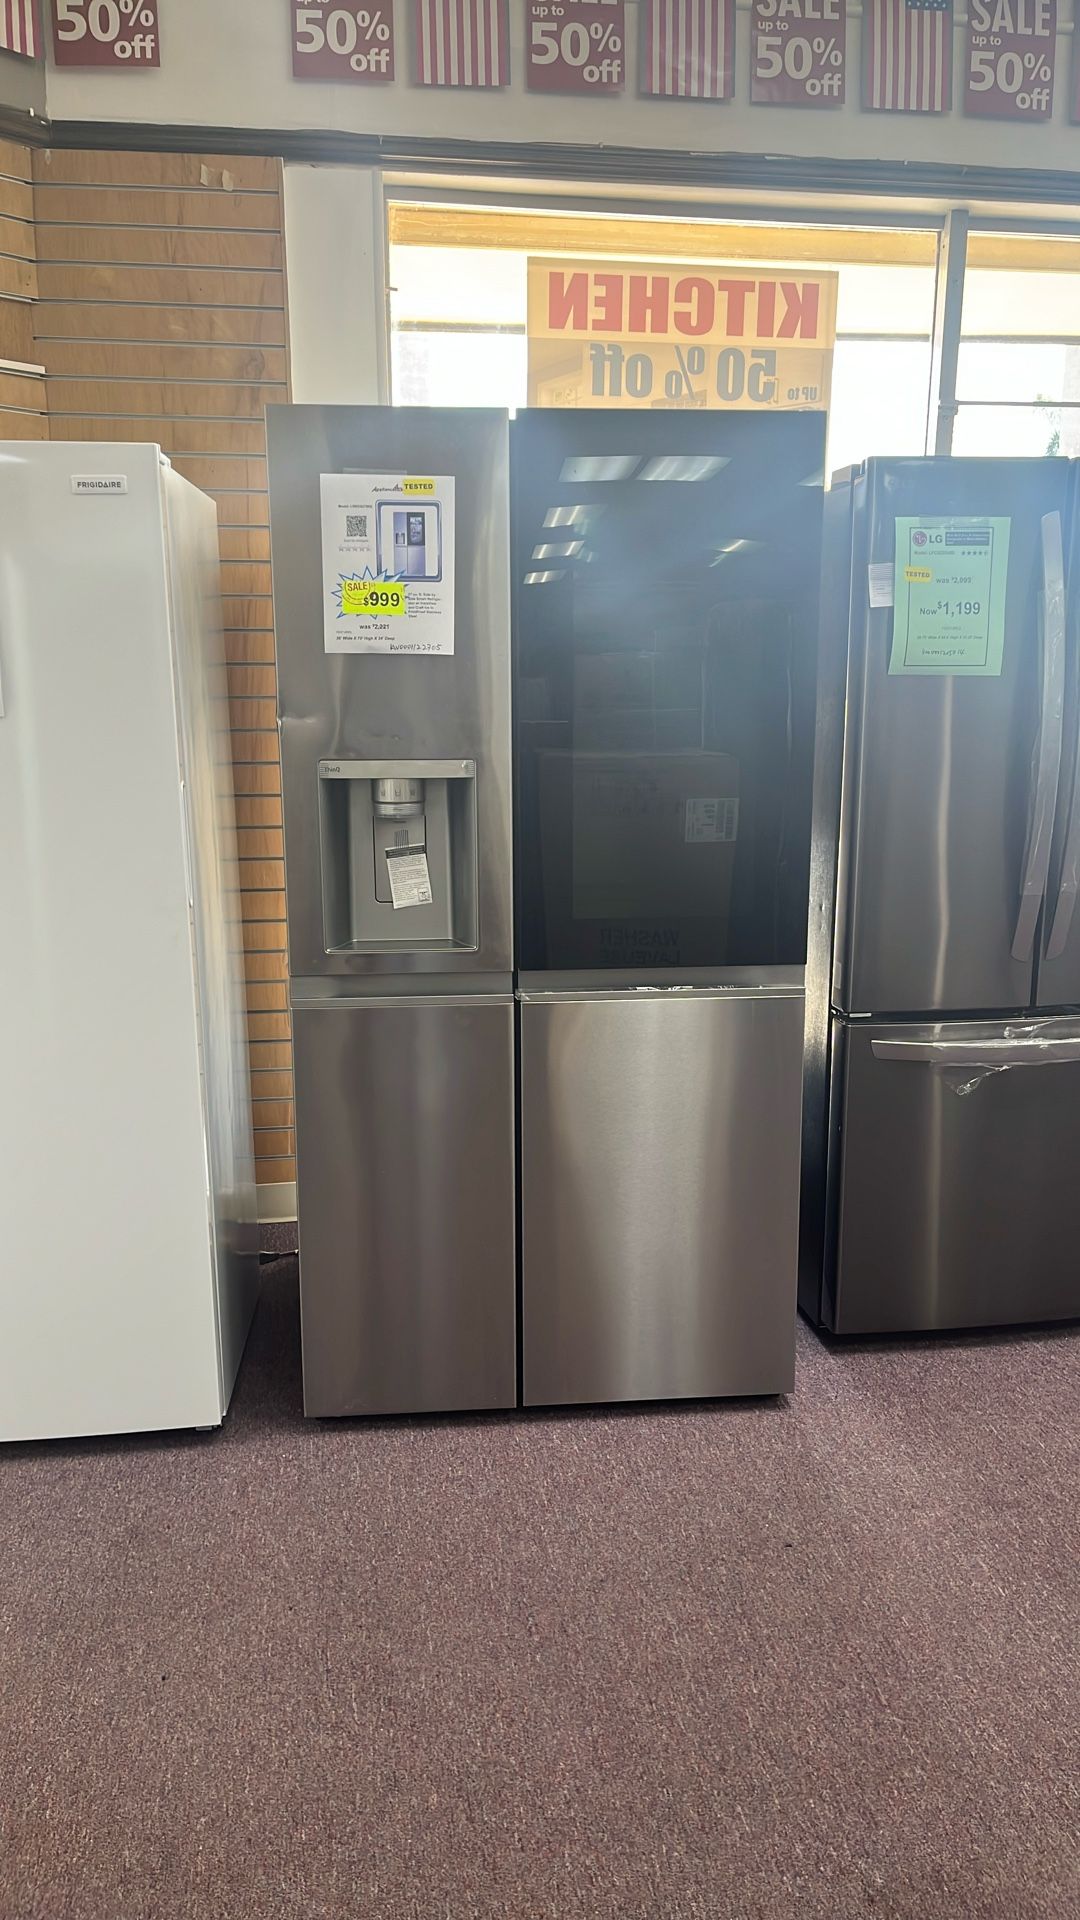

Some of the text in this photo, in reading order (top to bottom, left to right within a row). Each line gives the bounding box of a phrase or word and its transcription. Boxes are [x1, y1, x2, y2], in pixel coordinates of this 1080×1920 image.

[57, 0, 155, 42] 50%
[532, 5, 564, 18] up to
[971, 0, 1050, 37] SALE
[296, 9, 390, 55] 50%
[758, 20, 789, 32] up to
[113, 34, 155, 59] off
[531, 22, 622, 67] 50%
[972, 35, 1002, 47] up to
[350, 47, 390, 73] off
[756, 36, 843, 80] 50%
[583, 59, 621, 83] off
[969, 50, 1051, 94] 50%
[805, 72, 842, 96] off
[1015, 87, 1050, 111] off
[77, 481, 121, 489] FRIGIDAIRE
[928, 534, 943, 544] LG
[347, 582, 368, 592] SALE
[363, 591, 400, 607] $999
[920, 601, 981, 618] Now $1,199
